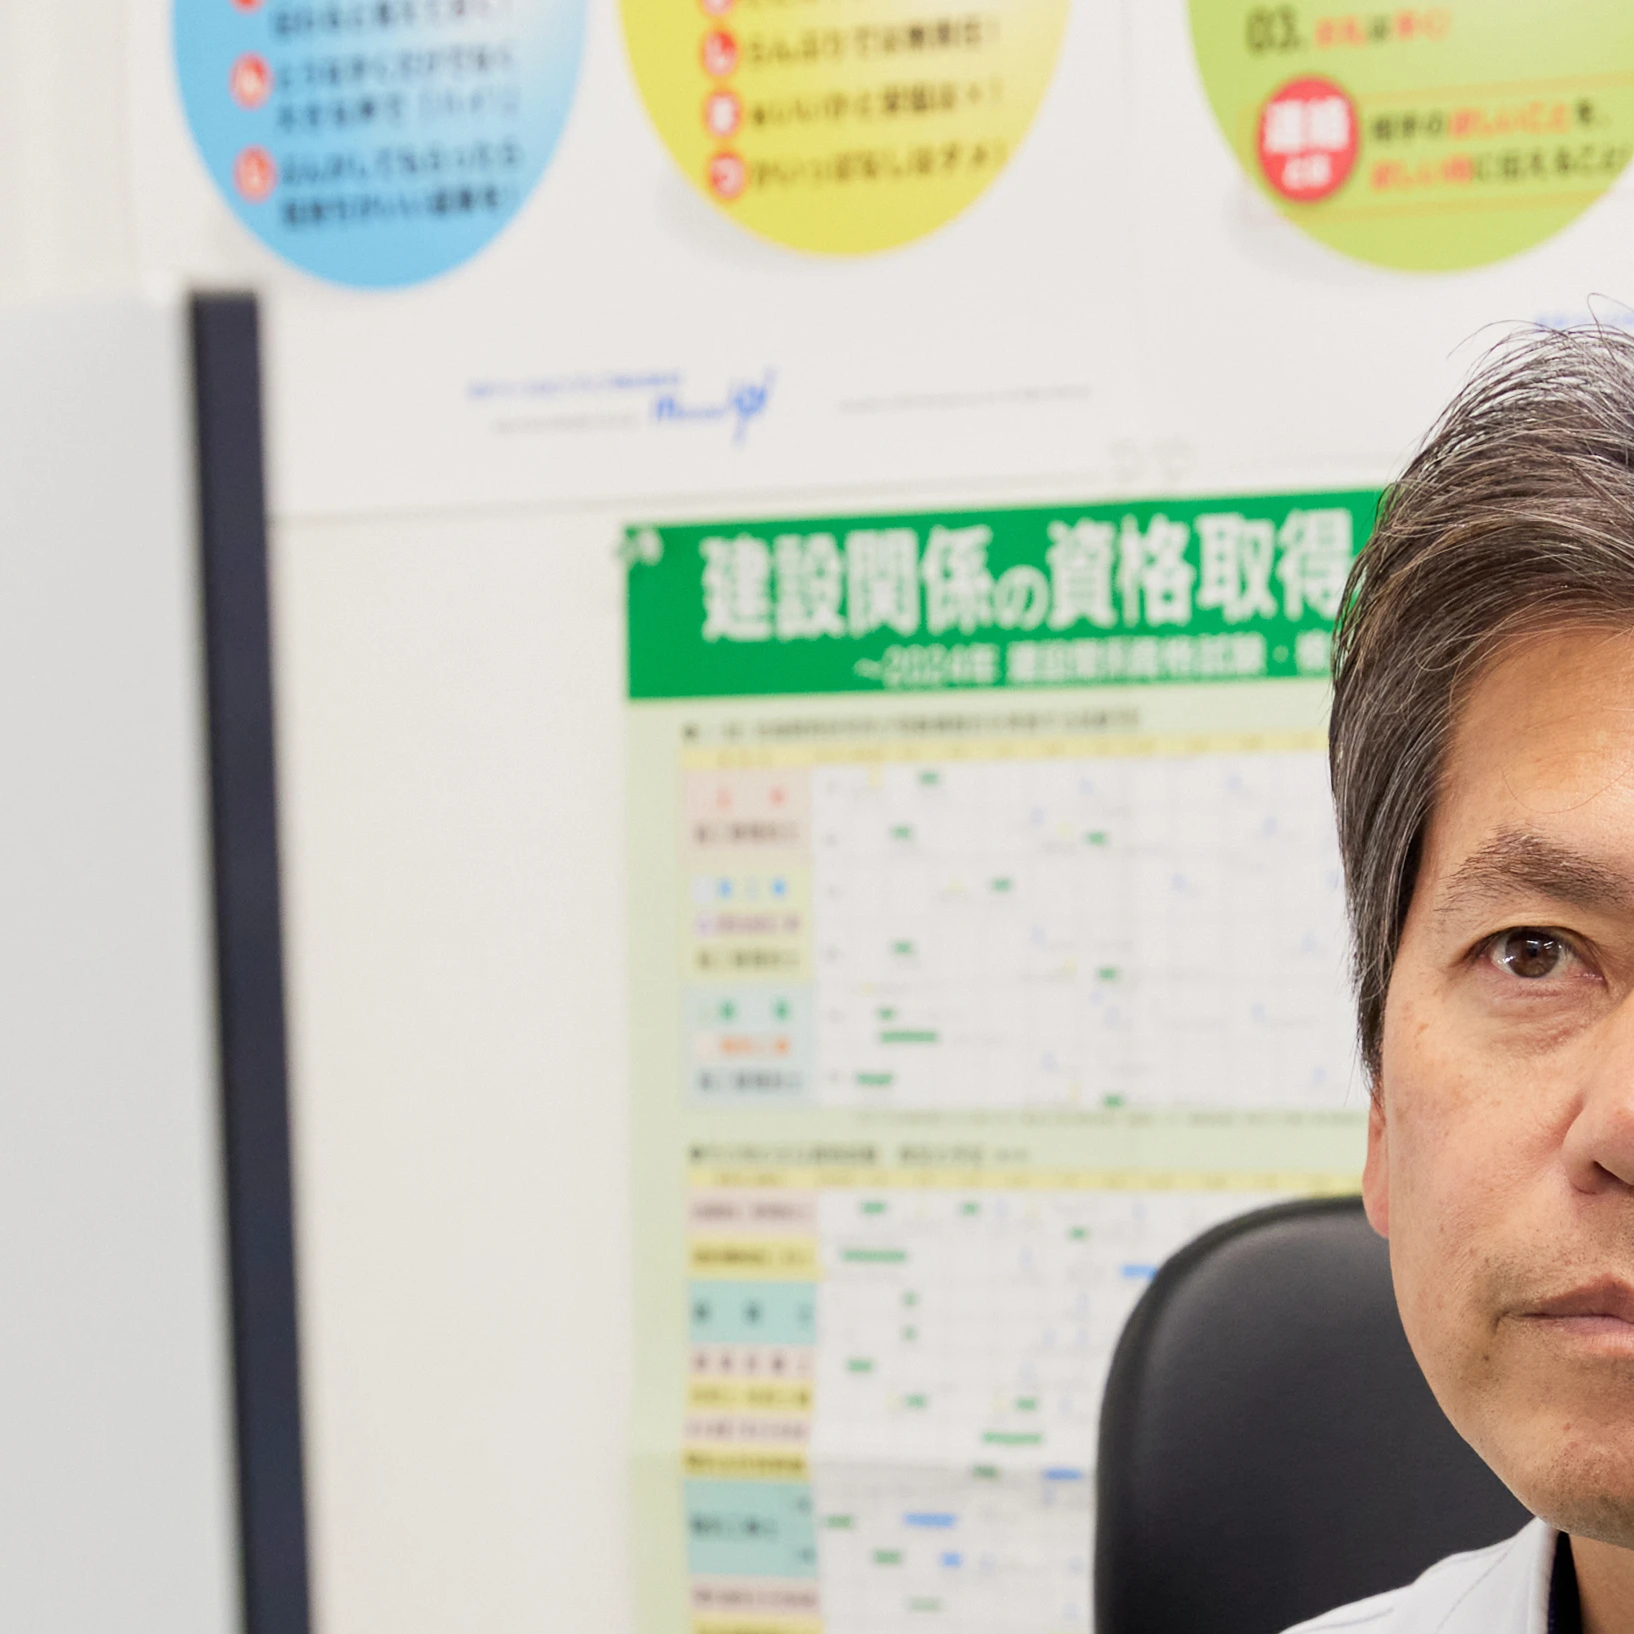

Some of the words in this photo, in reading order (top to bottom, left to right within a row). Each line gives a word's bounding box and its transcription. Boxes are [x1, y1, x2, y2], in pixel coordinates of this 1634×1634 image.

[700, 507, 1353, 642] 建設関係の資格取得
